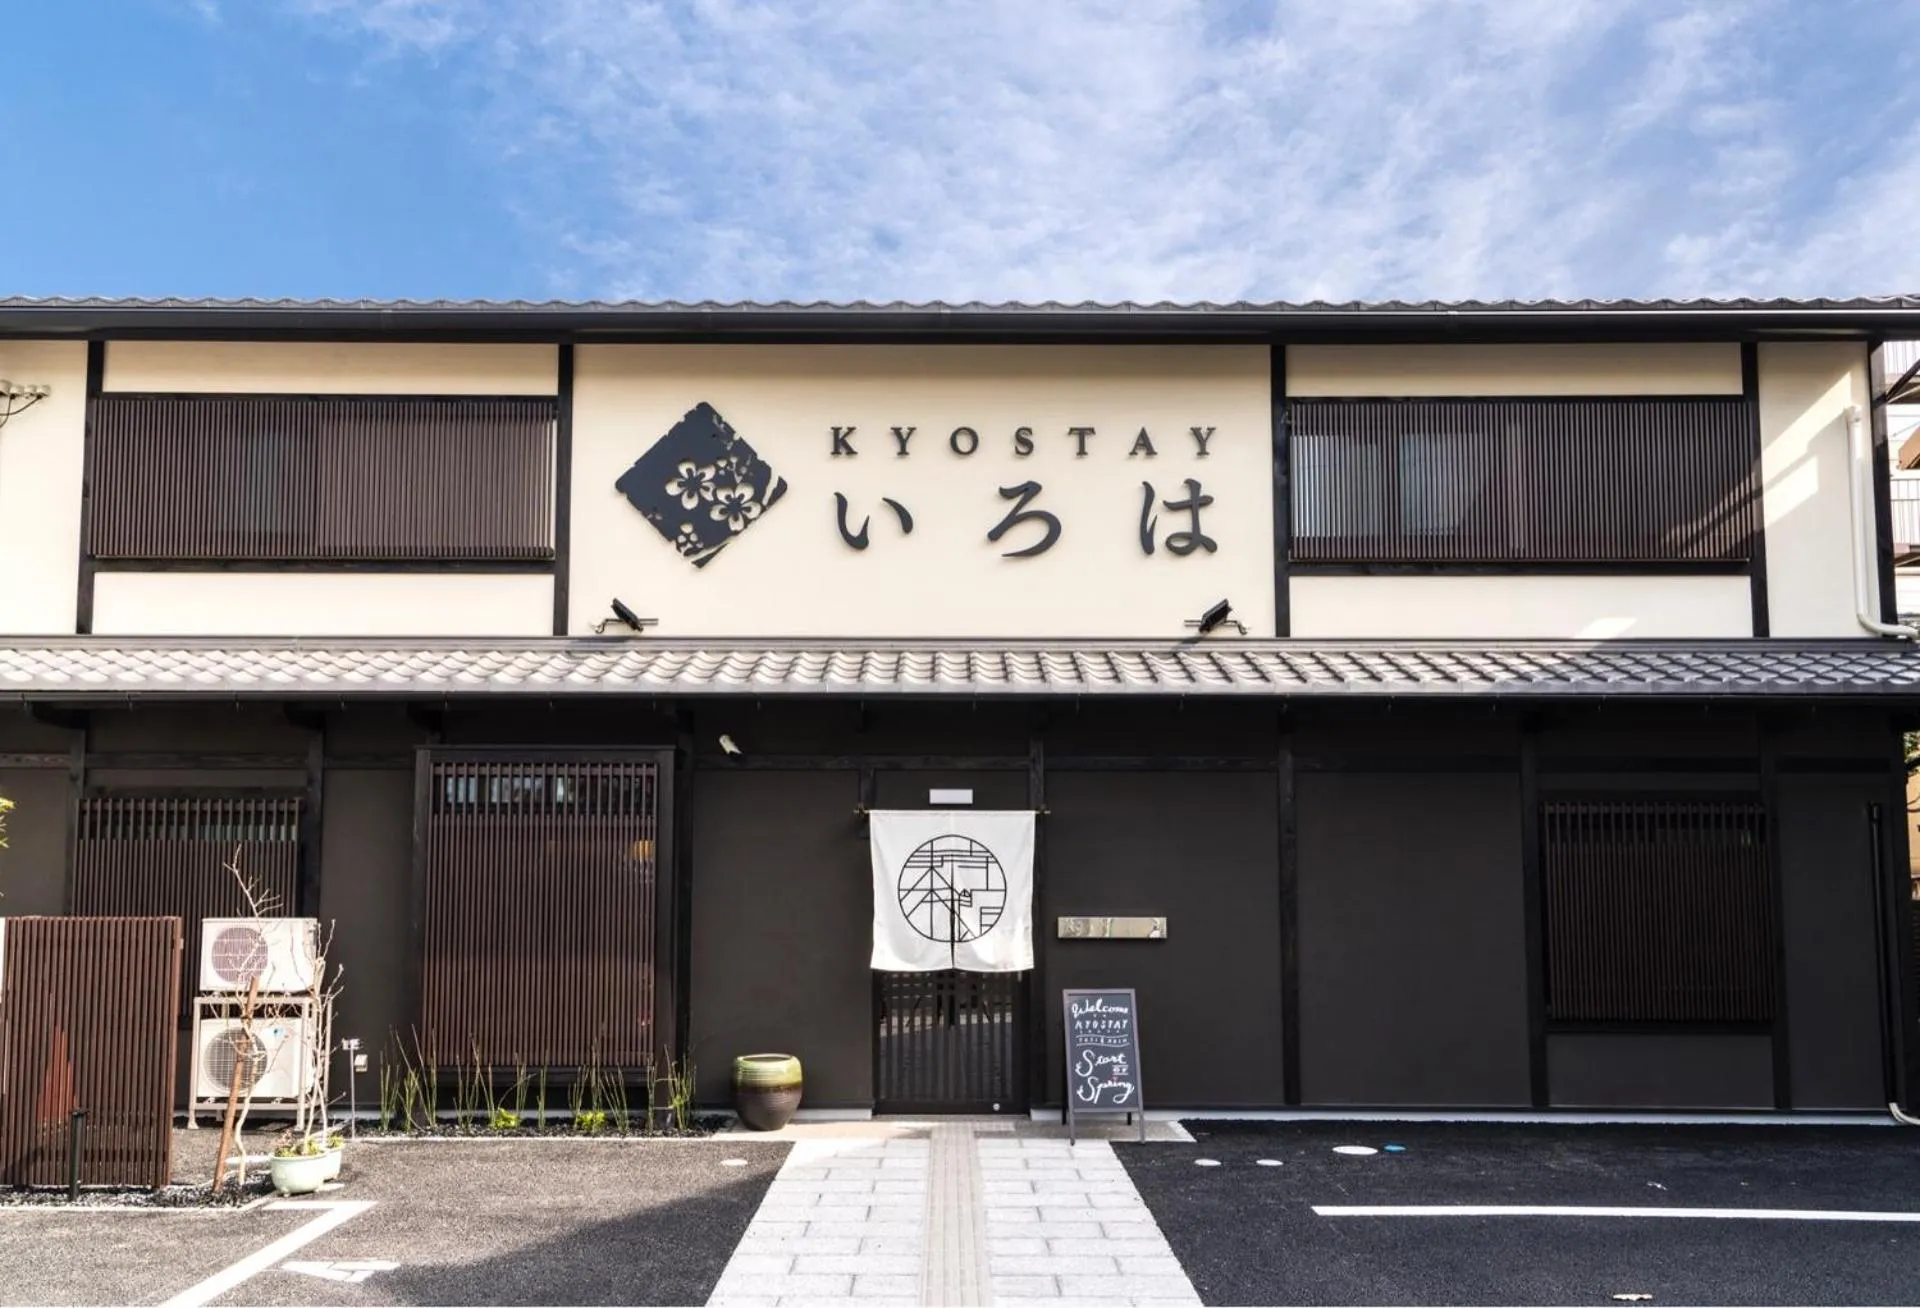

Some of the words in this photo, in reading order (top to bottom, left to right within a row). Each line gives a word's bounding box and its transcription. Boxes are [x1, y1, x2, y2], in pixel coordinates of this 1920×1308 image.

[830, 426, 1217, 458] KYOSTAY
[833, 478, 1219, 558] いろは
[1072, 998, 1129, 1018] Welcome
[1075, 1049, 1127, 1077] Start
[1076, 1076, 1135, 1105] Spring
